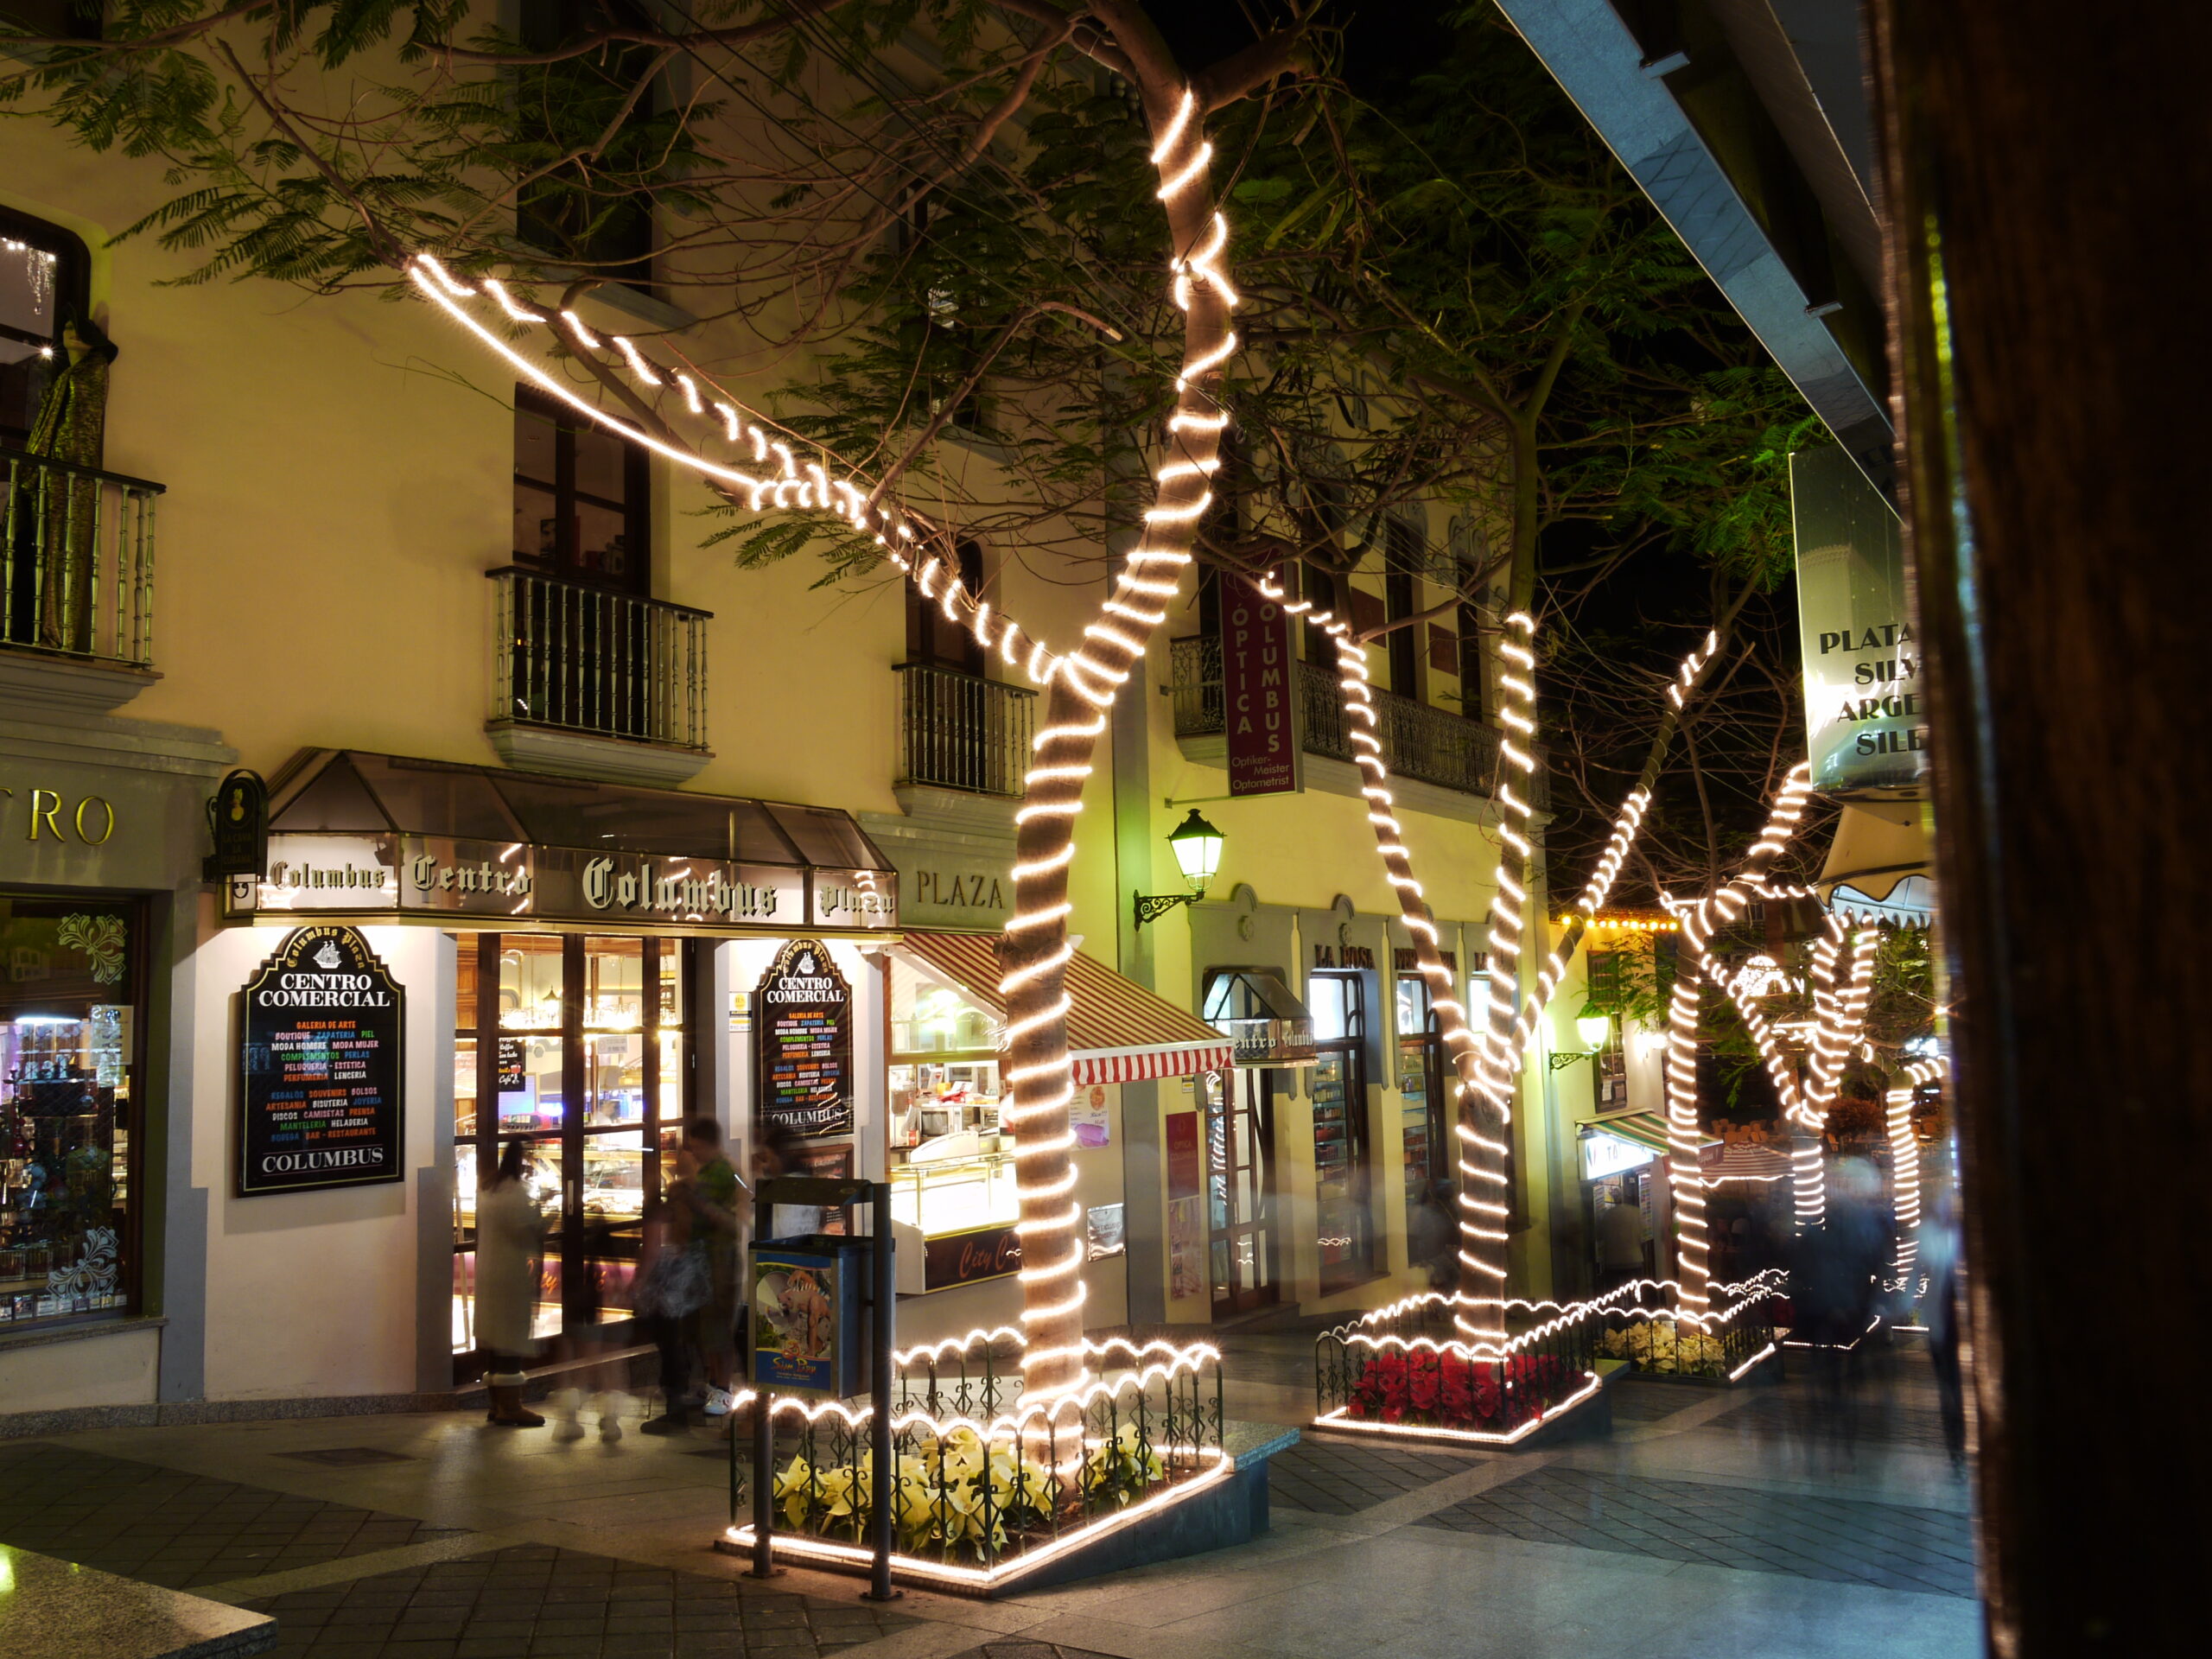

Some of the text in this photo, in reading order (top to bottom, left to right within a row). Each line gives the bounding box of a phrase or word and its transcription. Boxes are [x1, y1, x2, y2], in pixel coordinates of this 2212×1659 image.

[1259, 605, 1281, 753] OLUMBUS
[1231, 754, 1271, 768] Optiker-
[1254, 764, 1289, 776] Meister
[1232, 774, 1289, 791] Optometrist
[270, 861, 385, 891] Columbus
[413, 854, 532, 895] Centro
[582, 855, 779, 918] Columbus
[917, 870, 1005, 910] PLAZA
[287, 925, 365, 969] Columbus Plaza
[1314, 944, 1336, 969] LA
[281, 974, 372, 990] CENTRO
[779, 977, 833, 991] CENTRO
[259, 990, 391, 1007] COMERCIAL
[766, 990, 844, 1003] COMERCIAL
[296, 1021, 327, 1030] GALERIA
[338, 1020, 356, 1029] ARTE
[275, 1032, 311, 1040] BOUTIQUE
[316, 1031, 356, 1039] ZAPATERIA
[271, 1039, 379, 1051] MODA HOMBRE MODA MUJER
[281, 1052, 340, 1061] COMPLEMENTOS
[284, 1062, 327, 1071] PELUQUERIA
[334, 1061, 366, 1070] ESTETICA
[283, 1071, 366, 1082] PERFUMERIA LENCERIA
[351, 1087, 378, 1096] BOLSOS
[265, 1101, 308, 1111] ARTESANIA
[312, 1098, 348, 1108] BISUTERIA
[272, 1107, 375, 1121] DISCOS CAMISETAS PRENSA
[772, 1108, 842, 1125] COLUMBUS
[280, 1117, 368, 1130] MANTELERIA HELADERIA
[305, 1131, 321, 1140] BAR
[327, 1127, 377, 1139] RESTAURANTE
[263, 1147, 384, 1173] COLUMBUS
[959, 1242, 991, 1279] City
